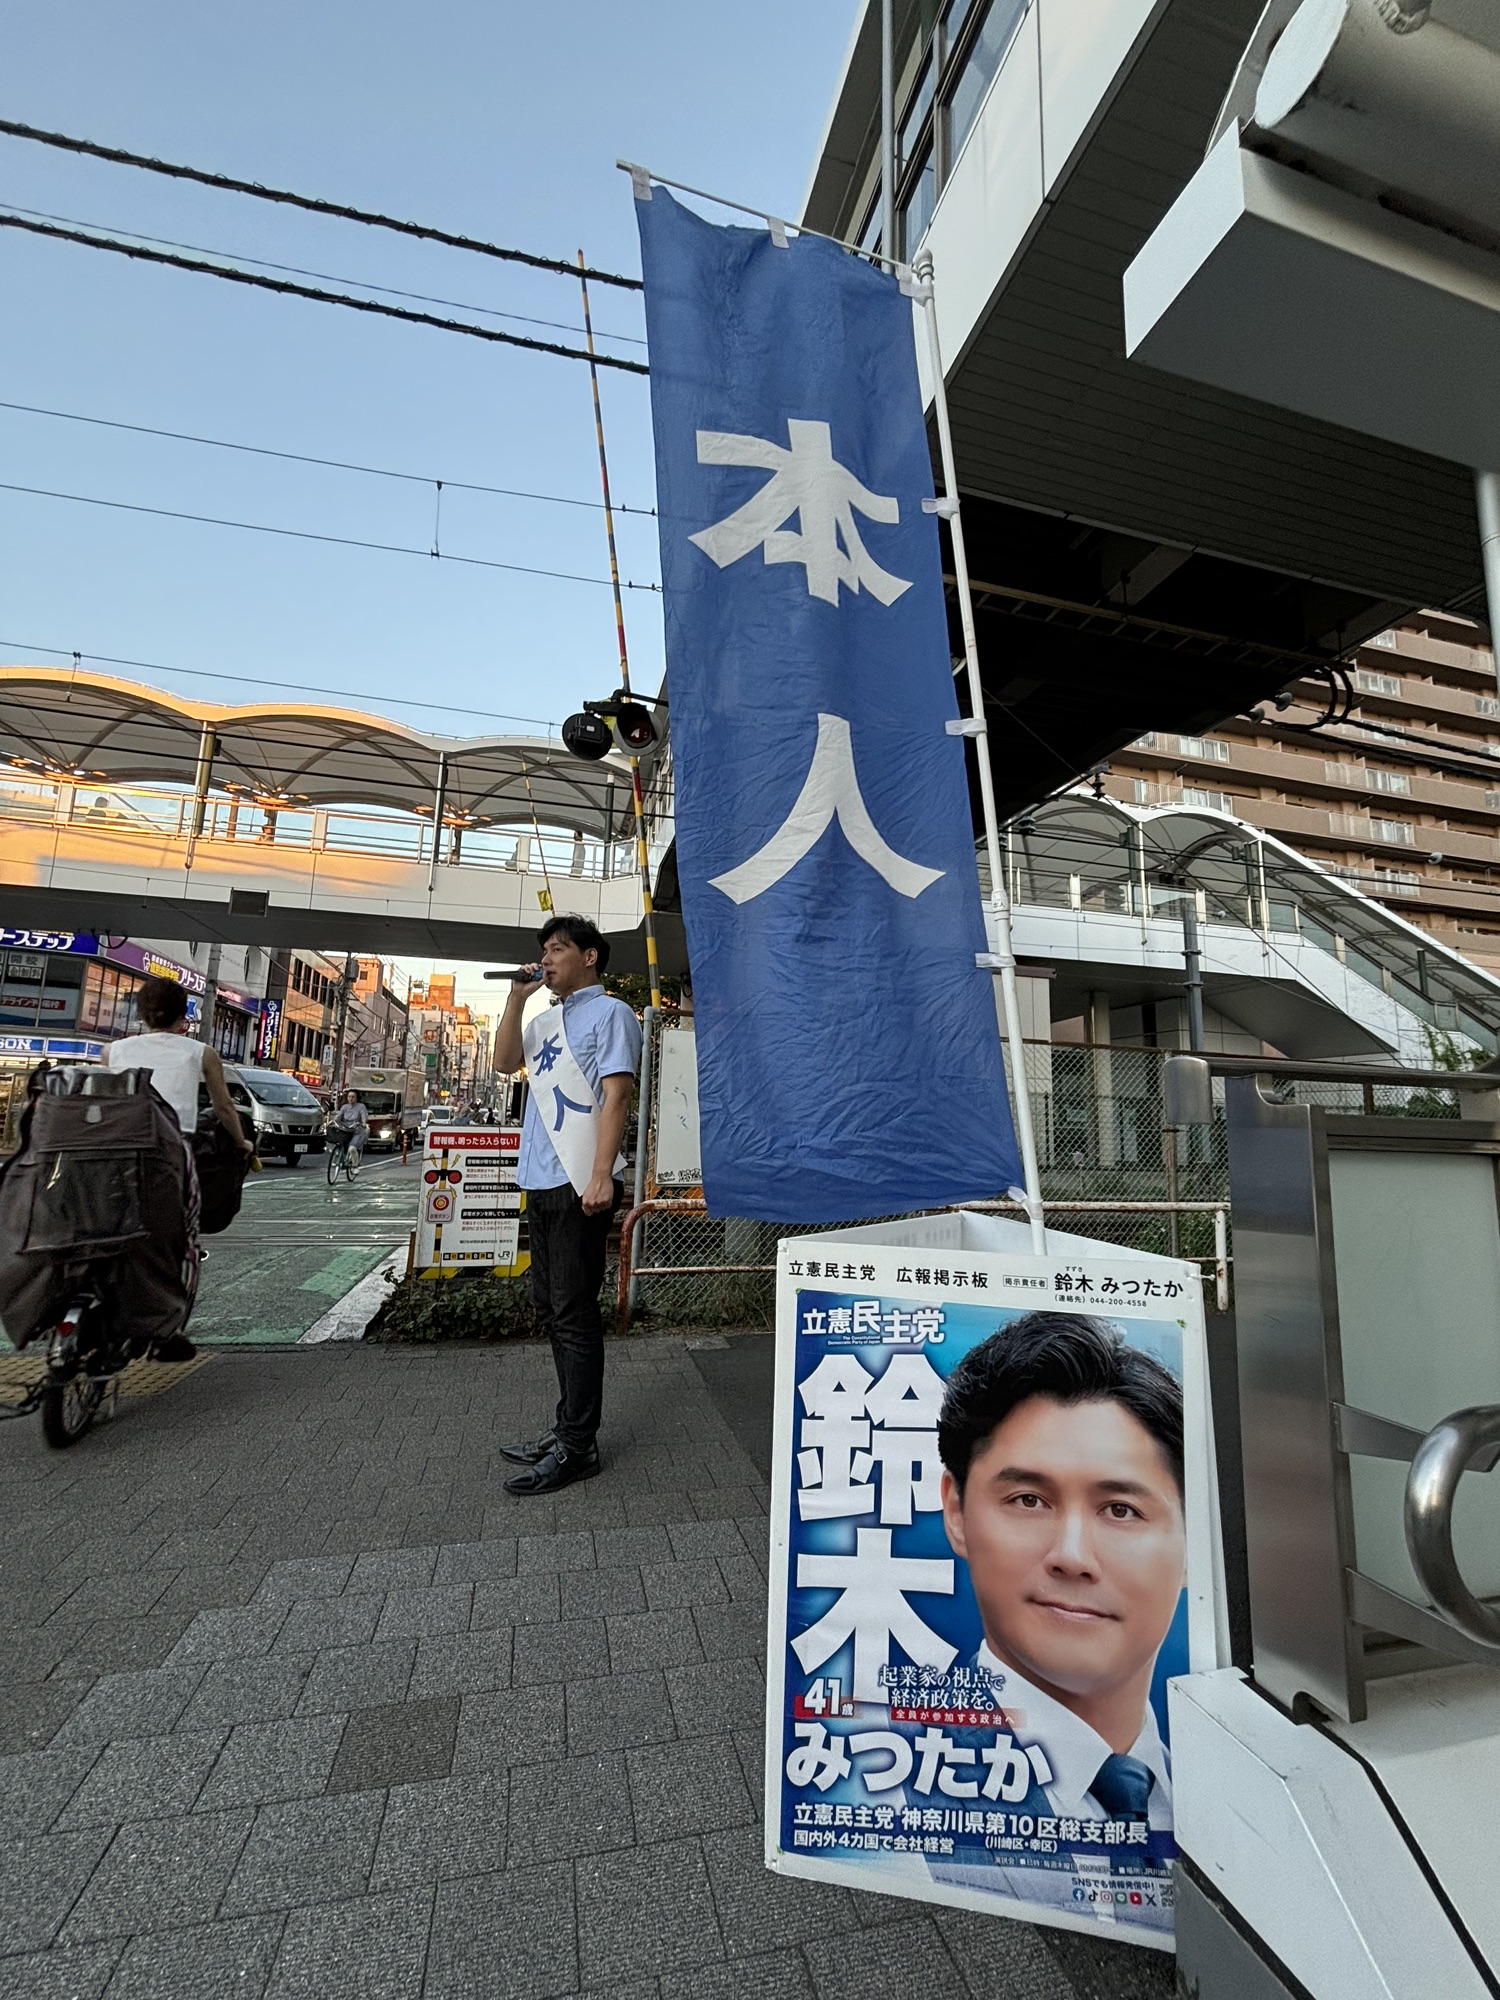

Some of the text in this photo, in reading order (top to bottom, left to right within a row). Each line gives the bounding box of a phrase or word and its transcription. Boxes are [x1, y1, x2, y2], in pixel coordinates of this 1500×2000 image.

[687, 418, 948, 905] 本人
[532, 1032, 593, 1132] 本人
[788, 1260, 989, 1289] 立憲民主党 広報掲示板
[1004, 1273, 1184, 1298] 掲示責任者 鈴木 みつたか
[1090, 1297, 1147, 1307] 044-200-4558
[802, 1300, 945, 1345] 立憲民主党
[790, 1353, 960, 1705] 鈴木
[879, 1666, 1005, 1690] 起業家の視点で
[891, 1688, 995, 1712] 経済政策を。
[895, 1709, 1015, 1726] 全員が参加する政治へ
[786, 1721, 1053, 1802] みつたか
[794, 1802, 895, 1830] 立憲民主党
